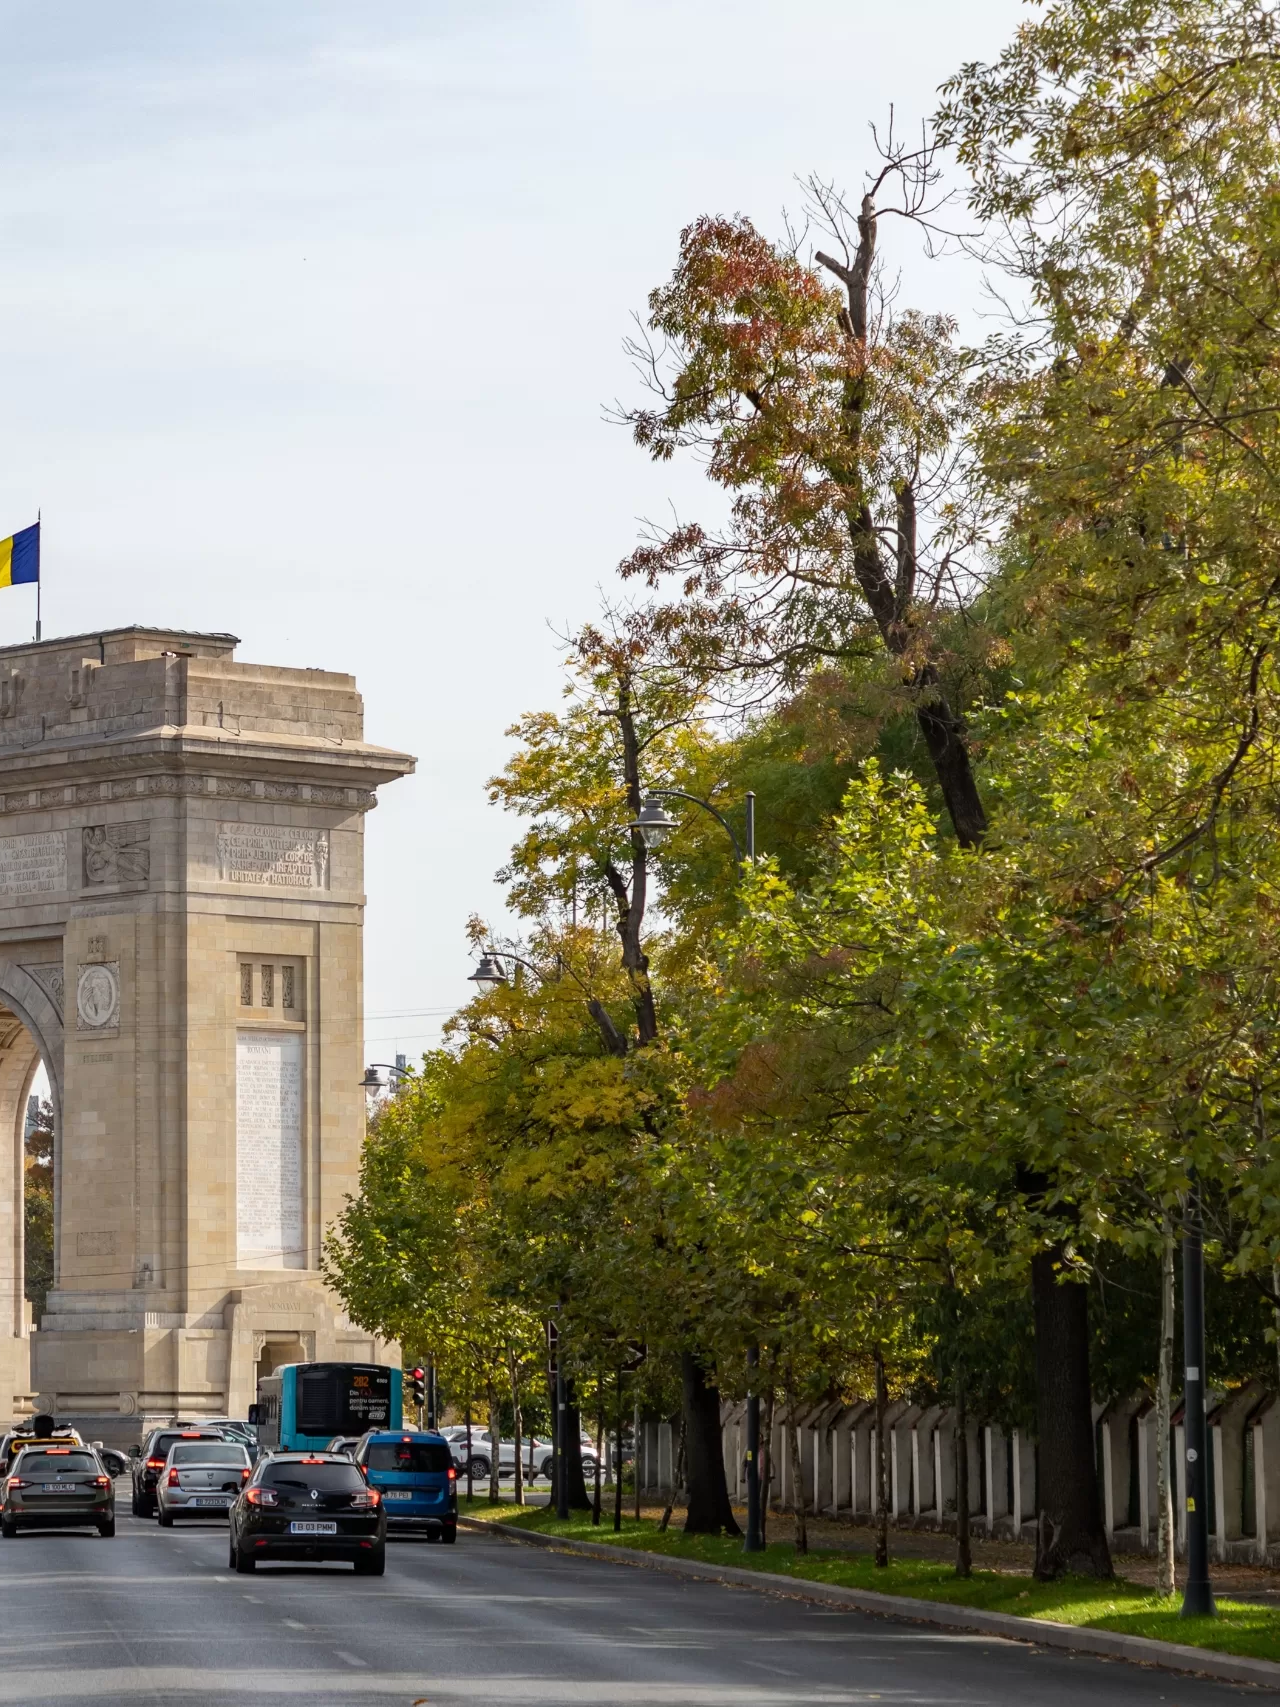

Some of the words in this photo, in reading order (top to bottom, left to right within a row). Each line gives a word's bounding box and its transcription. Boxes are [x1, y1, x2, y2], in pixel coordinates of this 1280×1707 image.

[254, 827, 281, 839] GLORIE
[289, 829, 314, 840] CELOR
[230, 838, 241, 847] CE
[246, 839, 264, 849] PRIN
[230, 849, 249, 860] PRIN
[285, 853, 299, 863] LOR
[304, 853, 314, 863] DE
[231, 871, 266, 882] UNITATEA
[271, 874, 313, 887] NATIONALA
[297, 1523, 304, 1531] B
[306, 1523, 315, 1531] 03
[317, 1523, 333, 1531] PMM
